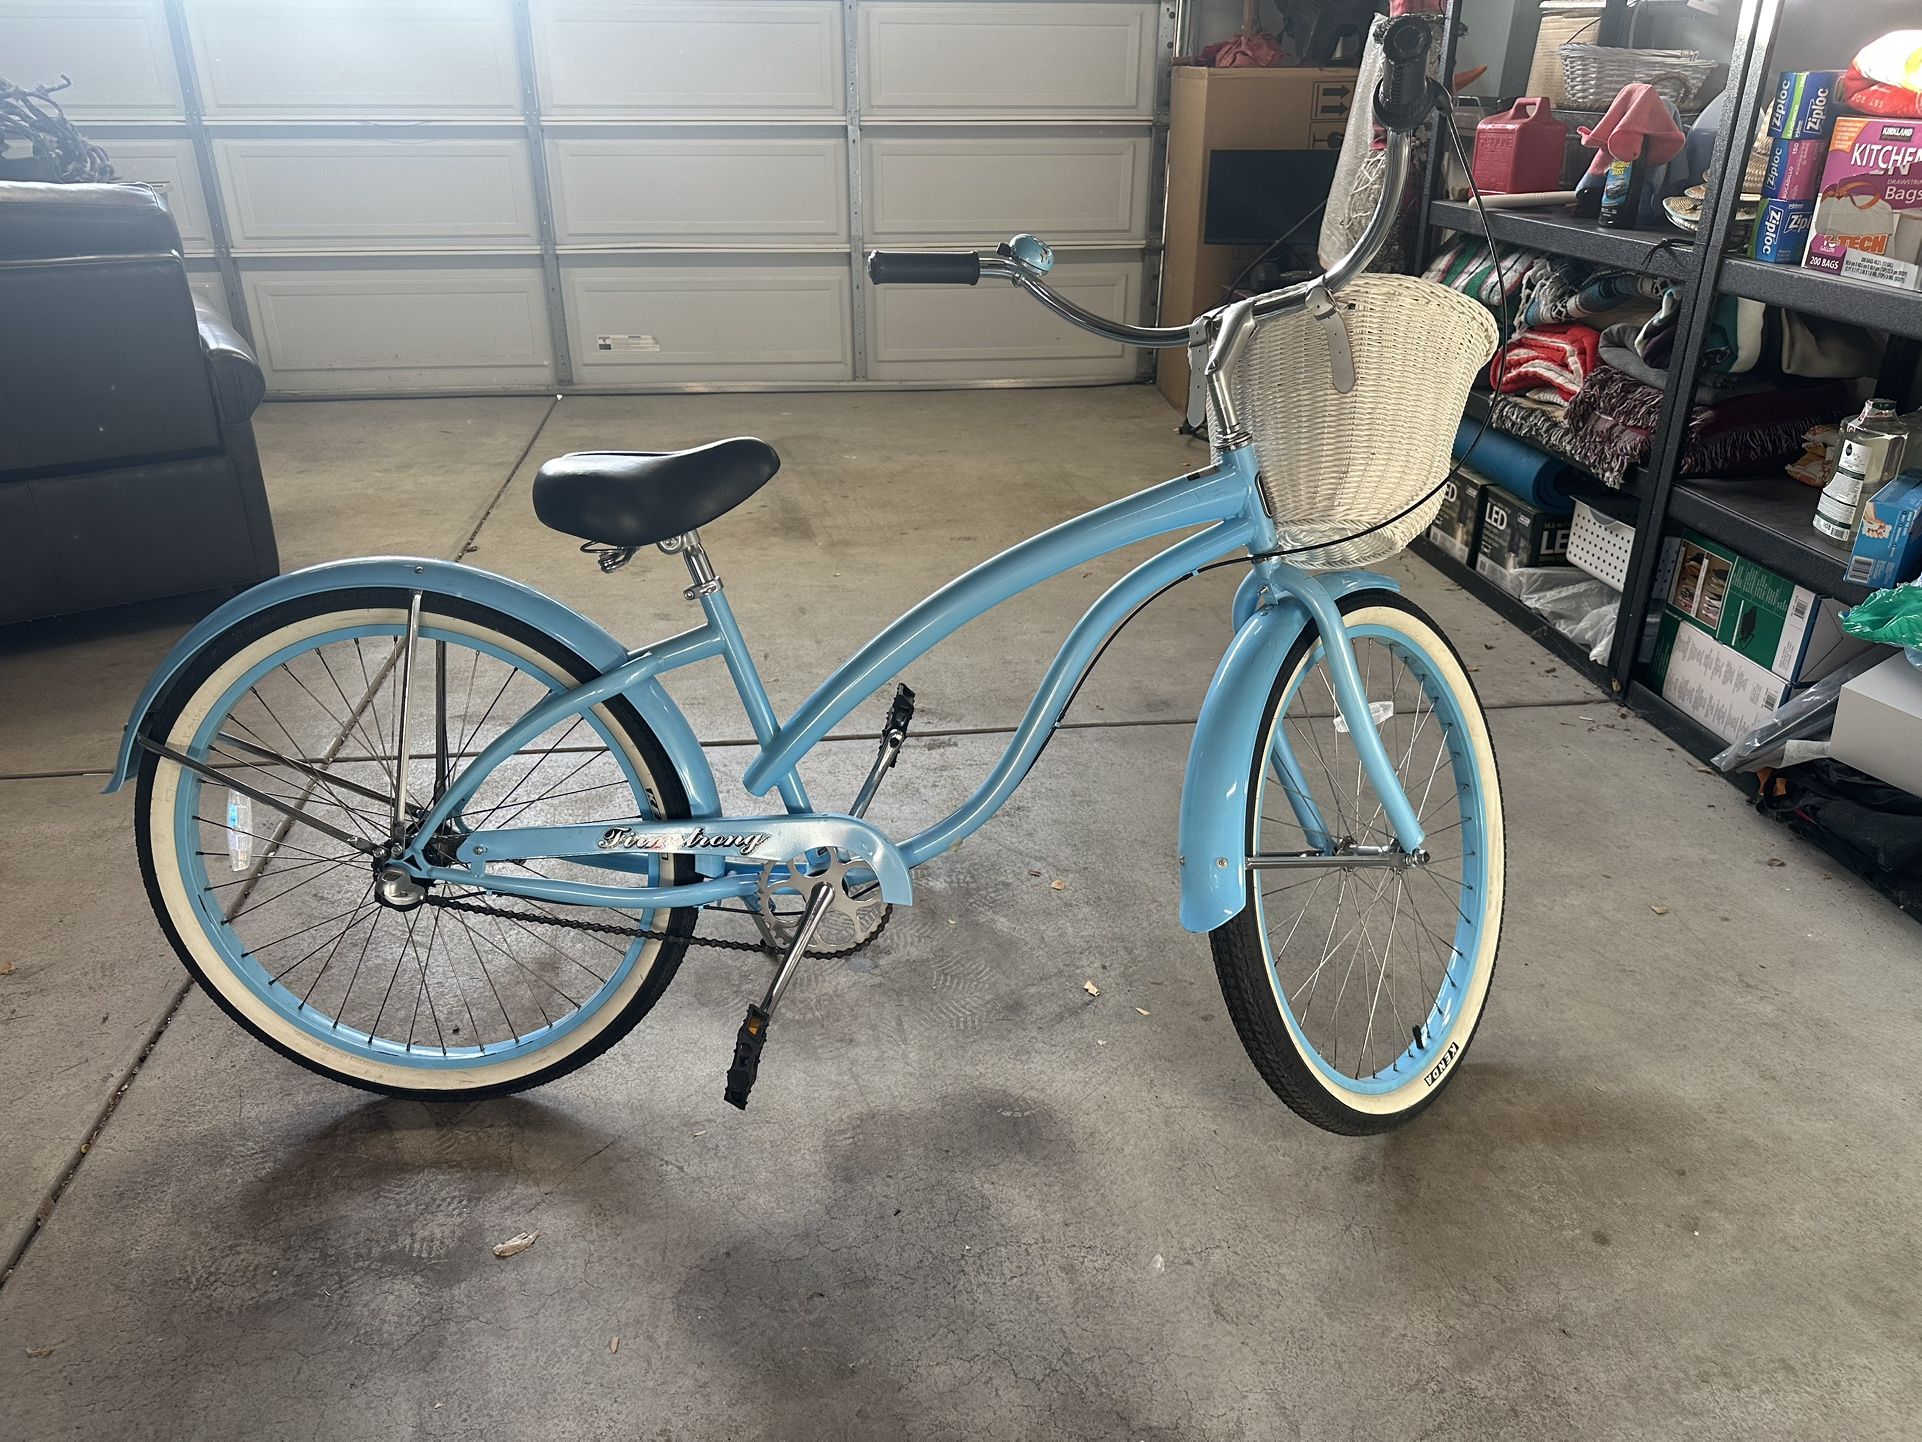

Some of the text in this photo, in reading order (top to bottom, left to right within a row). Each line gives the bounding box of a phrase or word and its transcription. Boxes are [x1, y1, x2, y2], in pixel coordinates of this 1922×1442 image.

[1771, 80, 1790, 127] Ziploc
[1806, 88, 1829, 130] Ziploc
[1882, 127, 1914, 137] KIRKLAND
[1767, 147, 1782, 186] Ziploc
[1763, 210, 1781, 255] Ziploc
[1789, 214, 1812, 232] Zipl
[1810, 256, 1839, 270] 200 BAGS
[1485, 502, 1507, 530] LED
[1541, 529, 1571, 555] LE
[1425, 1042, 1458, 1086] KENDA
